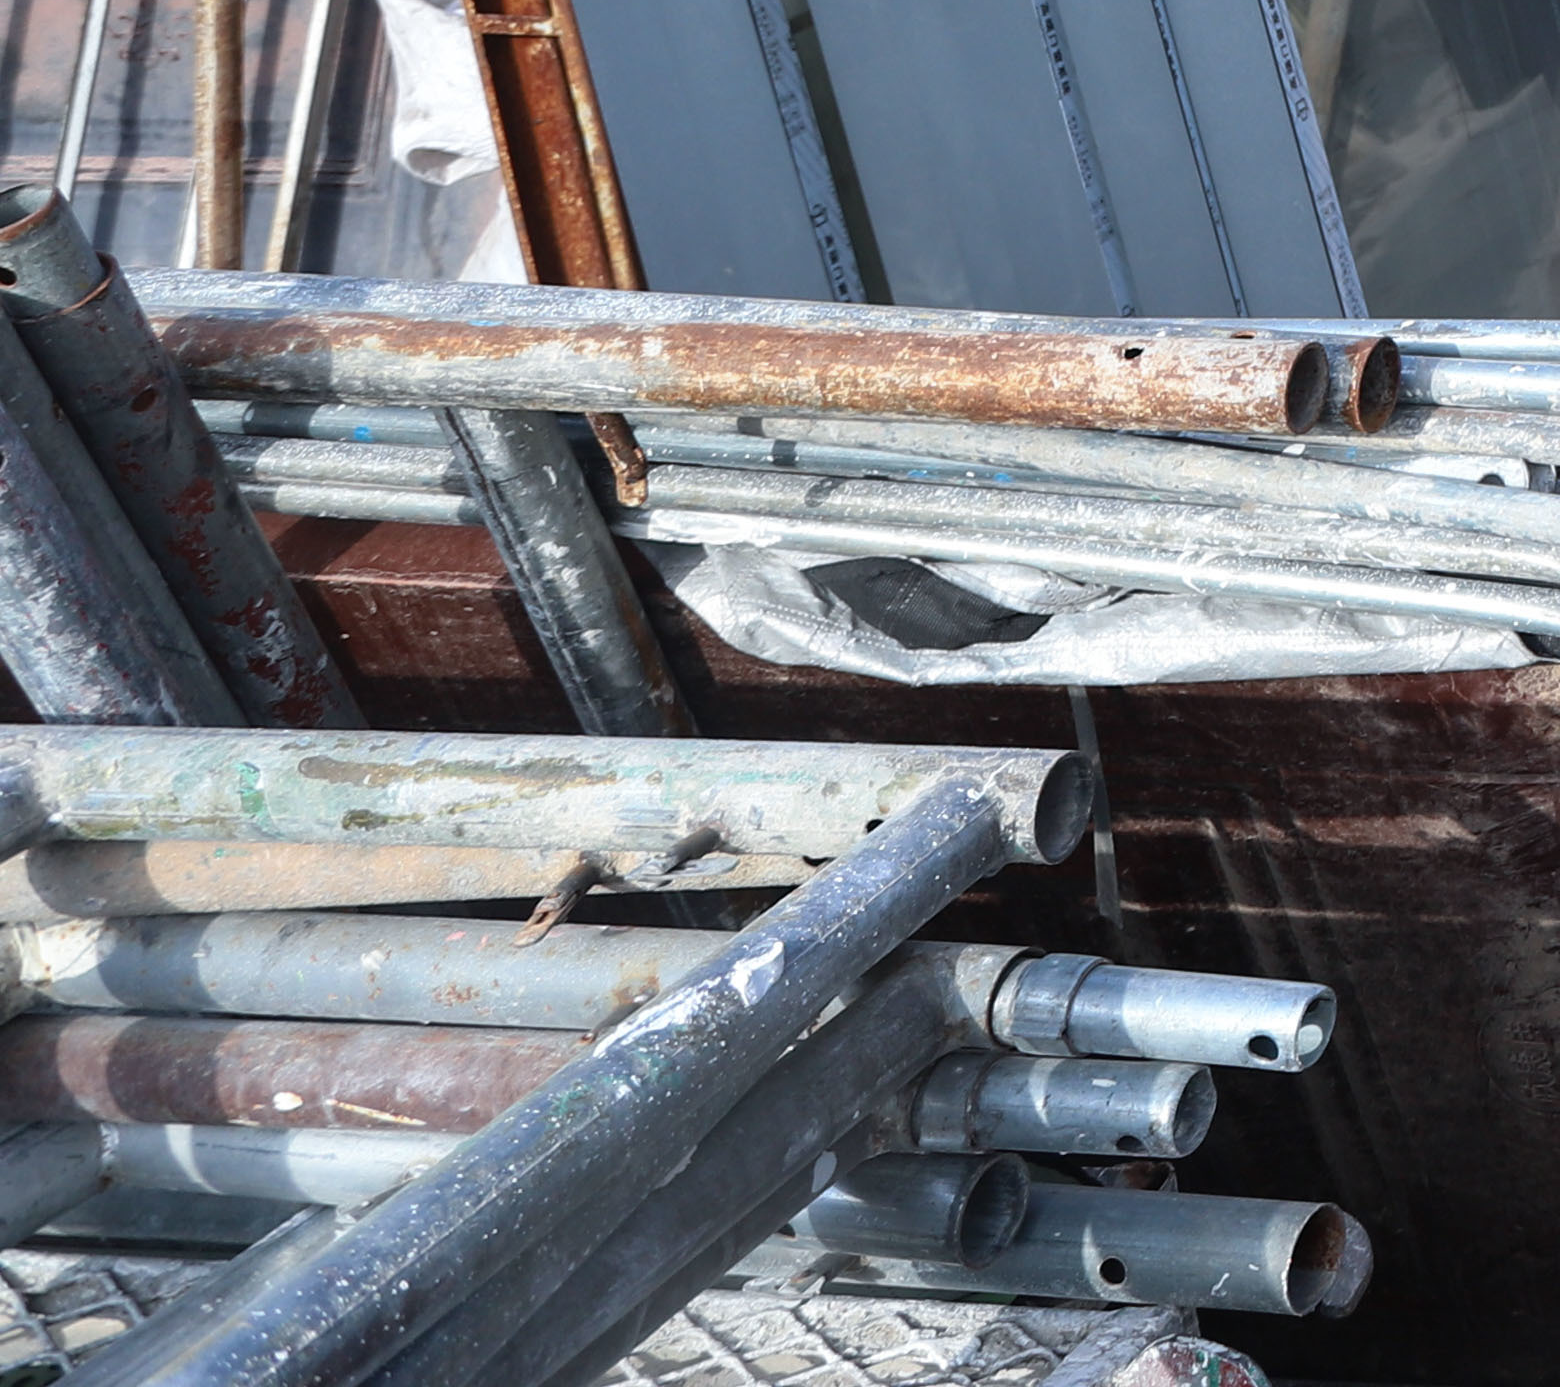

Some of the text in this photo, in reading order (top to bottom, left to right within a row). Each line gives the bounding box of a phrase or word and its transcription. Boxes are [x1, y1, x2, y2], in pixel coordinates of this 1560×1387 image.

[1039, 2, 1072, 95] 高端门窗系统
